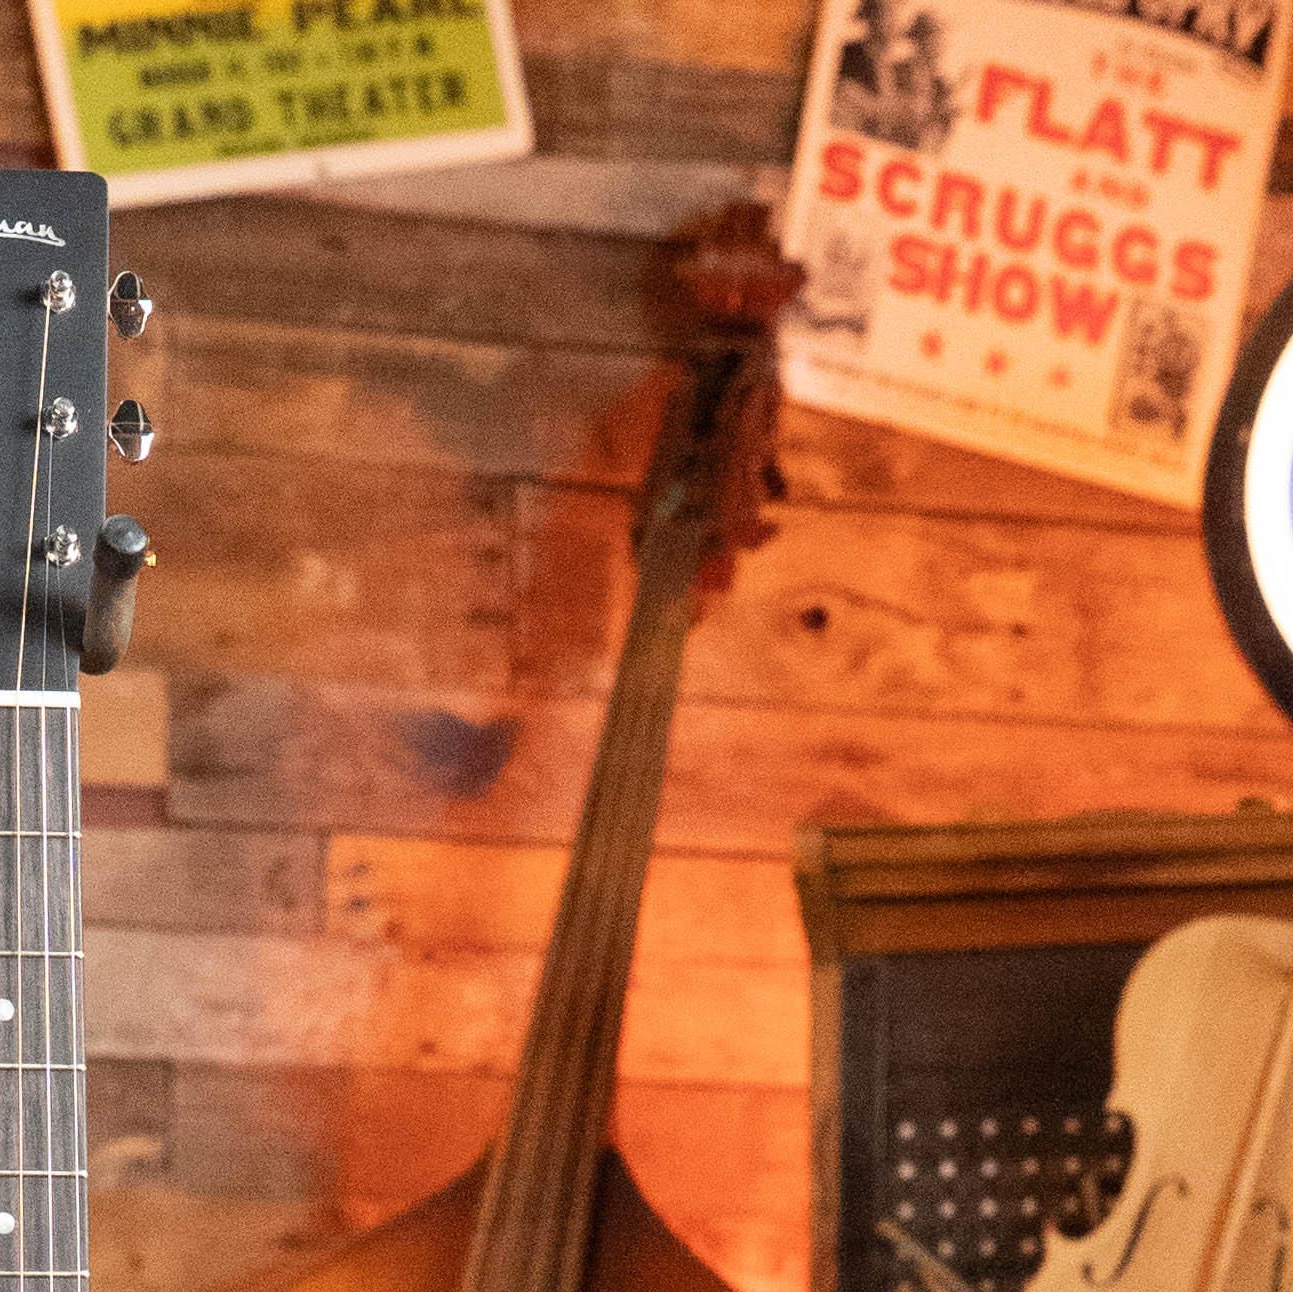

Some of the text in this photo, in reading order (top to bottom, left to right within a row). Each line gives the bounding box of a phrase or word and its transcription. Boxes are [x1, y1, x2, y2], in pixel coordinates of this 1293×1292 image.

[78, 9, 258, 58] MINNIE
[108, 98, 254, 148] GRAND
[277, 70, 467, 124] THEATER
[976, 63, 1242, 191] FLATT
[818, 140, 1217, 302] SCRUGGS
[889, 232, 1120, 346] SHOW
